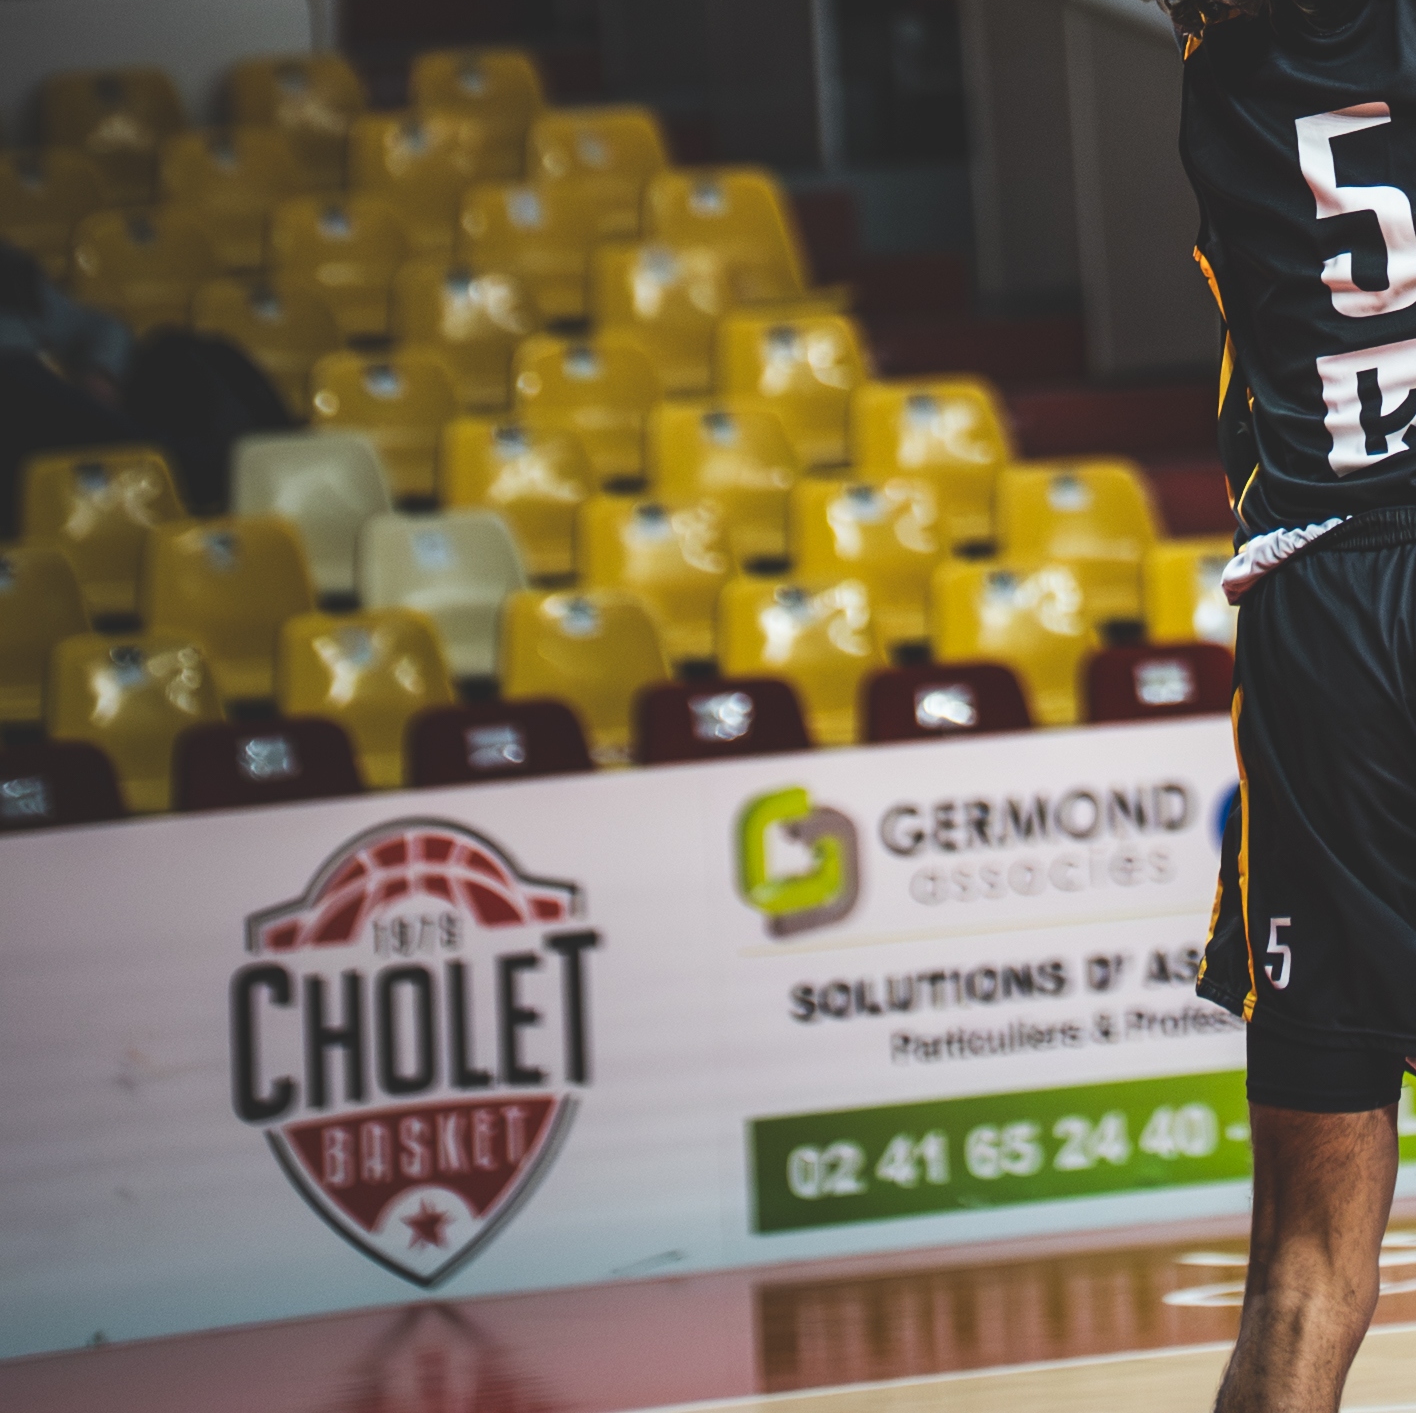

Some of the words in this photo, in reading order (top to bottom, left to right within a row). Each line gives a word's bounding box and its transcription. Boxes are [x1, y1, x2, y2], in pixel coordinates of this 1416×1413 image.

[878, 781, 1195, 858] GERMOND
[790, 959, 1068, 1023] SOLUTIONS
[1264, 917, 1292, 990] 5
[229, 928, 604, 1125] CHOLET
[890, 1015, 1083, 1065] Particuliers
[320, 1105, 528, 1188] BASKET
[787, 1140, 868, 1200] 02
[875, 1130, 950, 1189] 41
[964, 1121, 1045, 1179] 65
[1052, 1110, 1133, 1171] 24
[1138, 1101, 1219, 1160] 40
